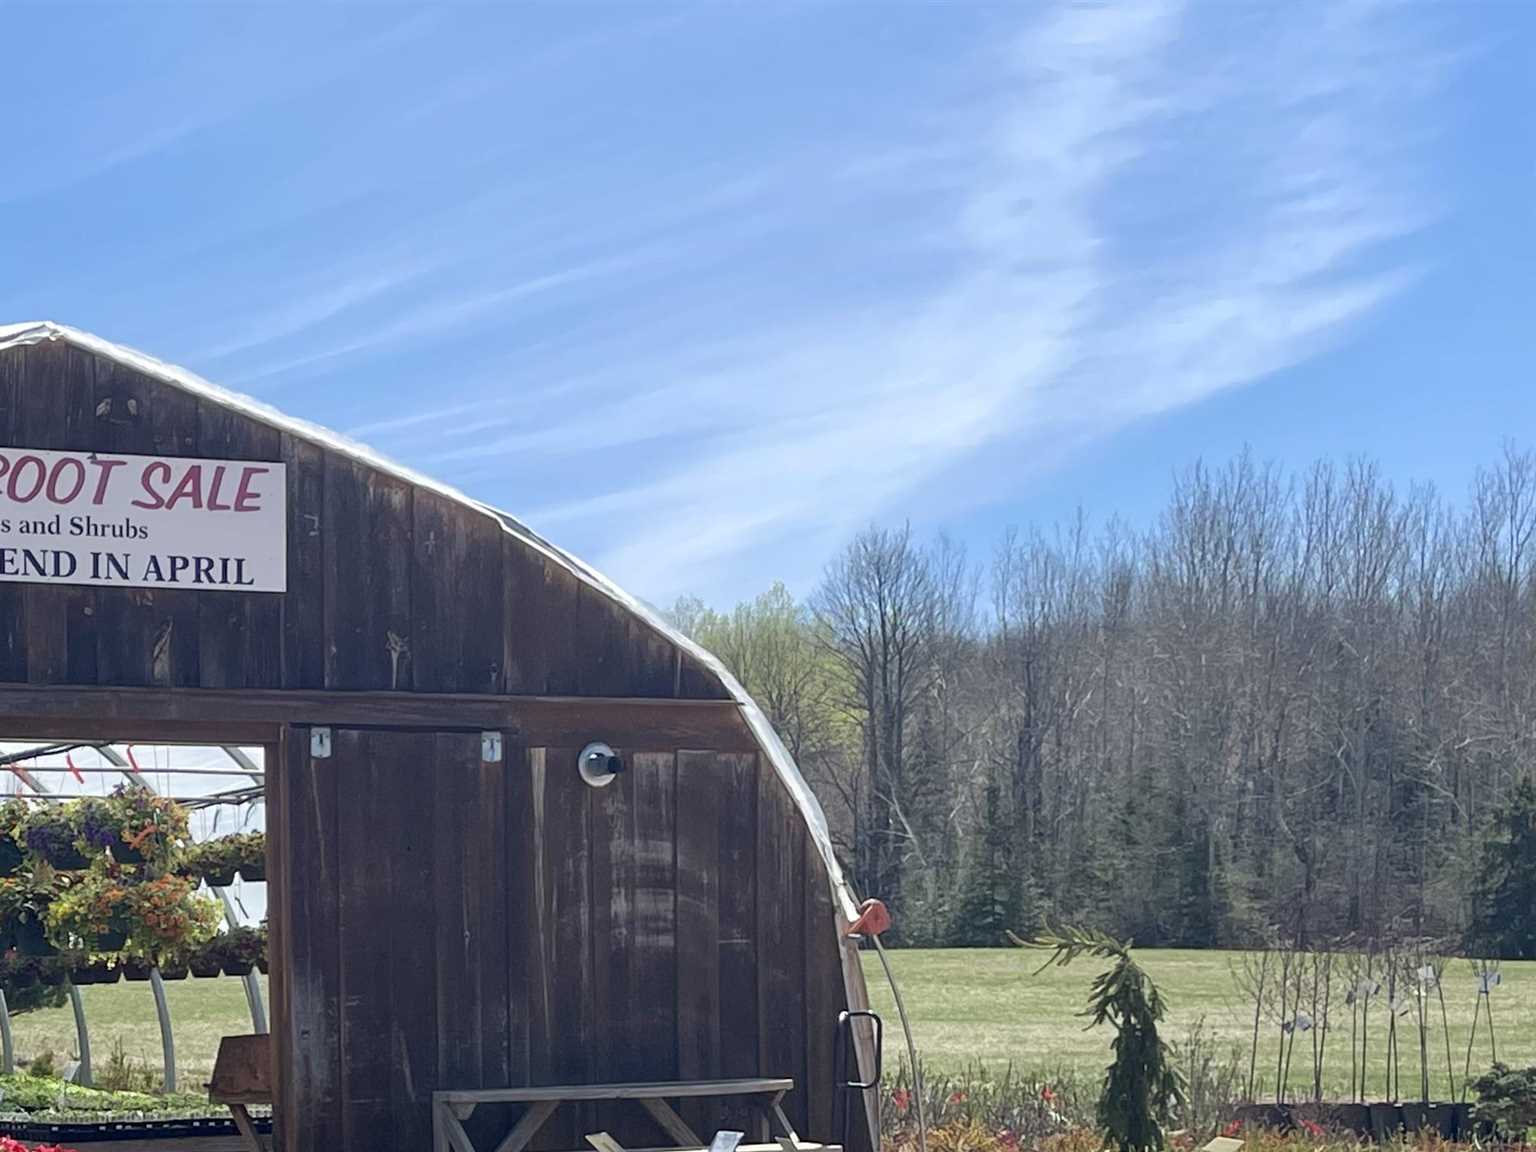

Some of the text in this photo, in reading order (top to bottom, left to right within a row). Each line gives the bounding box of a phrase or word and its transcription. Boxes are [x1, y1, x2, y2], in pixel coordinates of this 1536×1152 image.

[131, 461, 270, 512] SALE
[19, 514, 61, 535] and
[69, 515, 149, 540] Shrubs
[89, 551, 131, 580] IN
[142, 554, 255, 585] APRIL
